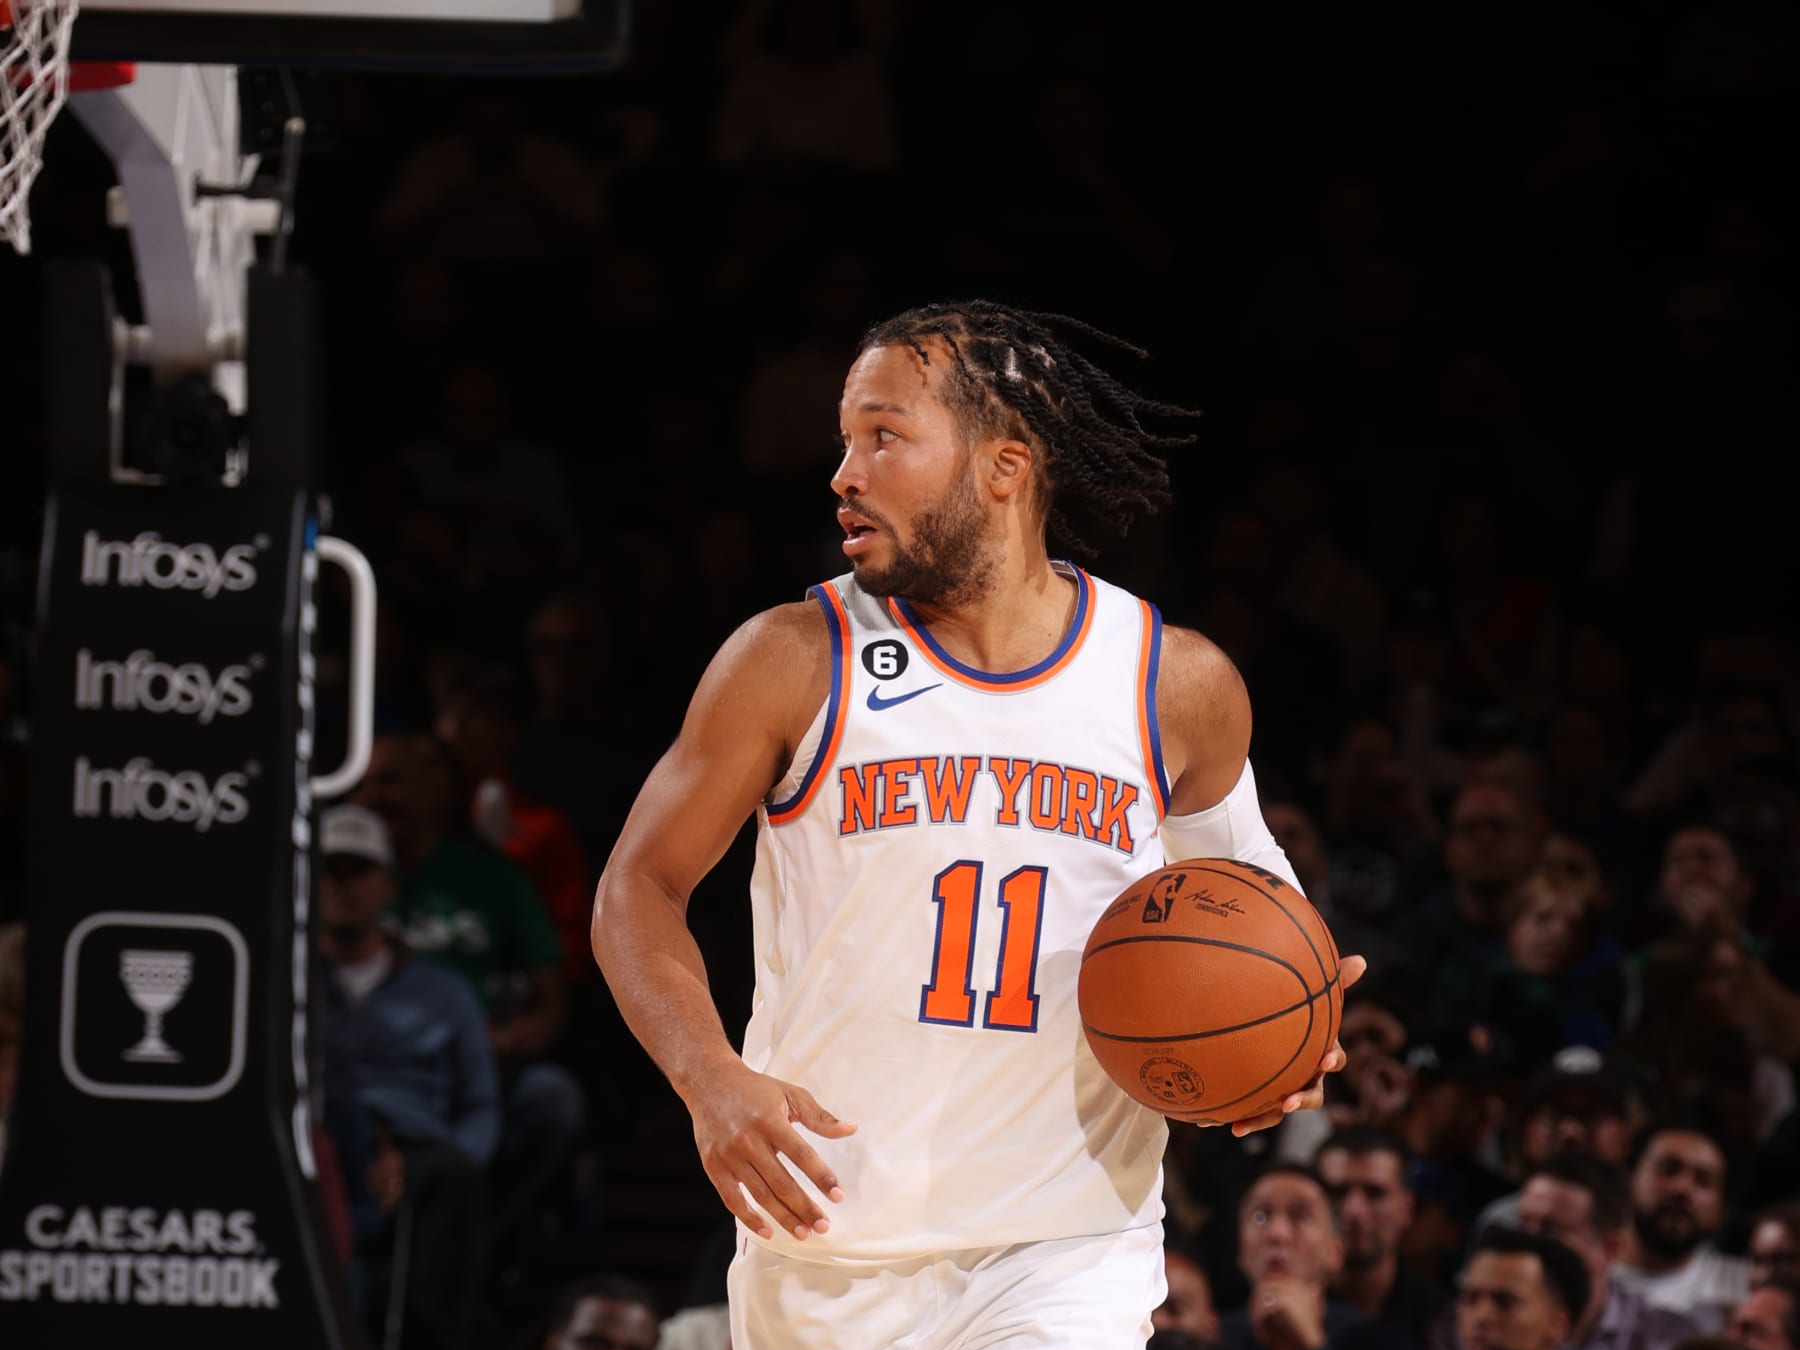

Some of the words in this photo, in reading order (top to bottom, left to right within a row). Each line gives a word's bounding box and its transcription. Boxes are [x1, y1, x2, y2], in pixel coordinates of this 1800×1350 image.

[81, 529, 257, 599] Infosys
[75, 647, 253, 725] Infosys
[872, 645, 898, 676] 6
[73, 755, 250, 832] Infosys
[838, 755, 982, 838] NEW
[986, 754, 1139, 857] YORK
[919, 859, 1049, 1033] 11
[25, 1204, 257, 1254] CAESARS
[0, 1250, 281, 1309] SPORTSBOOK
